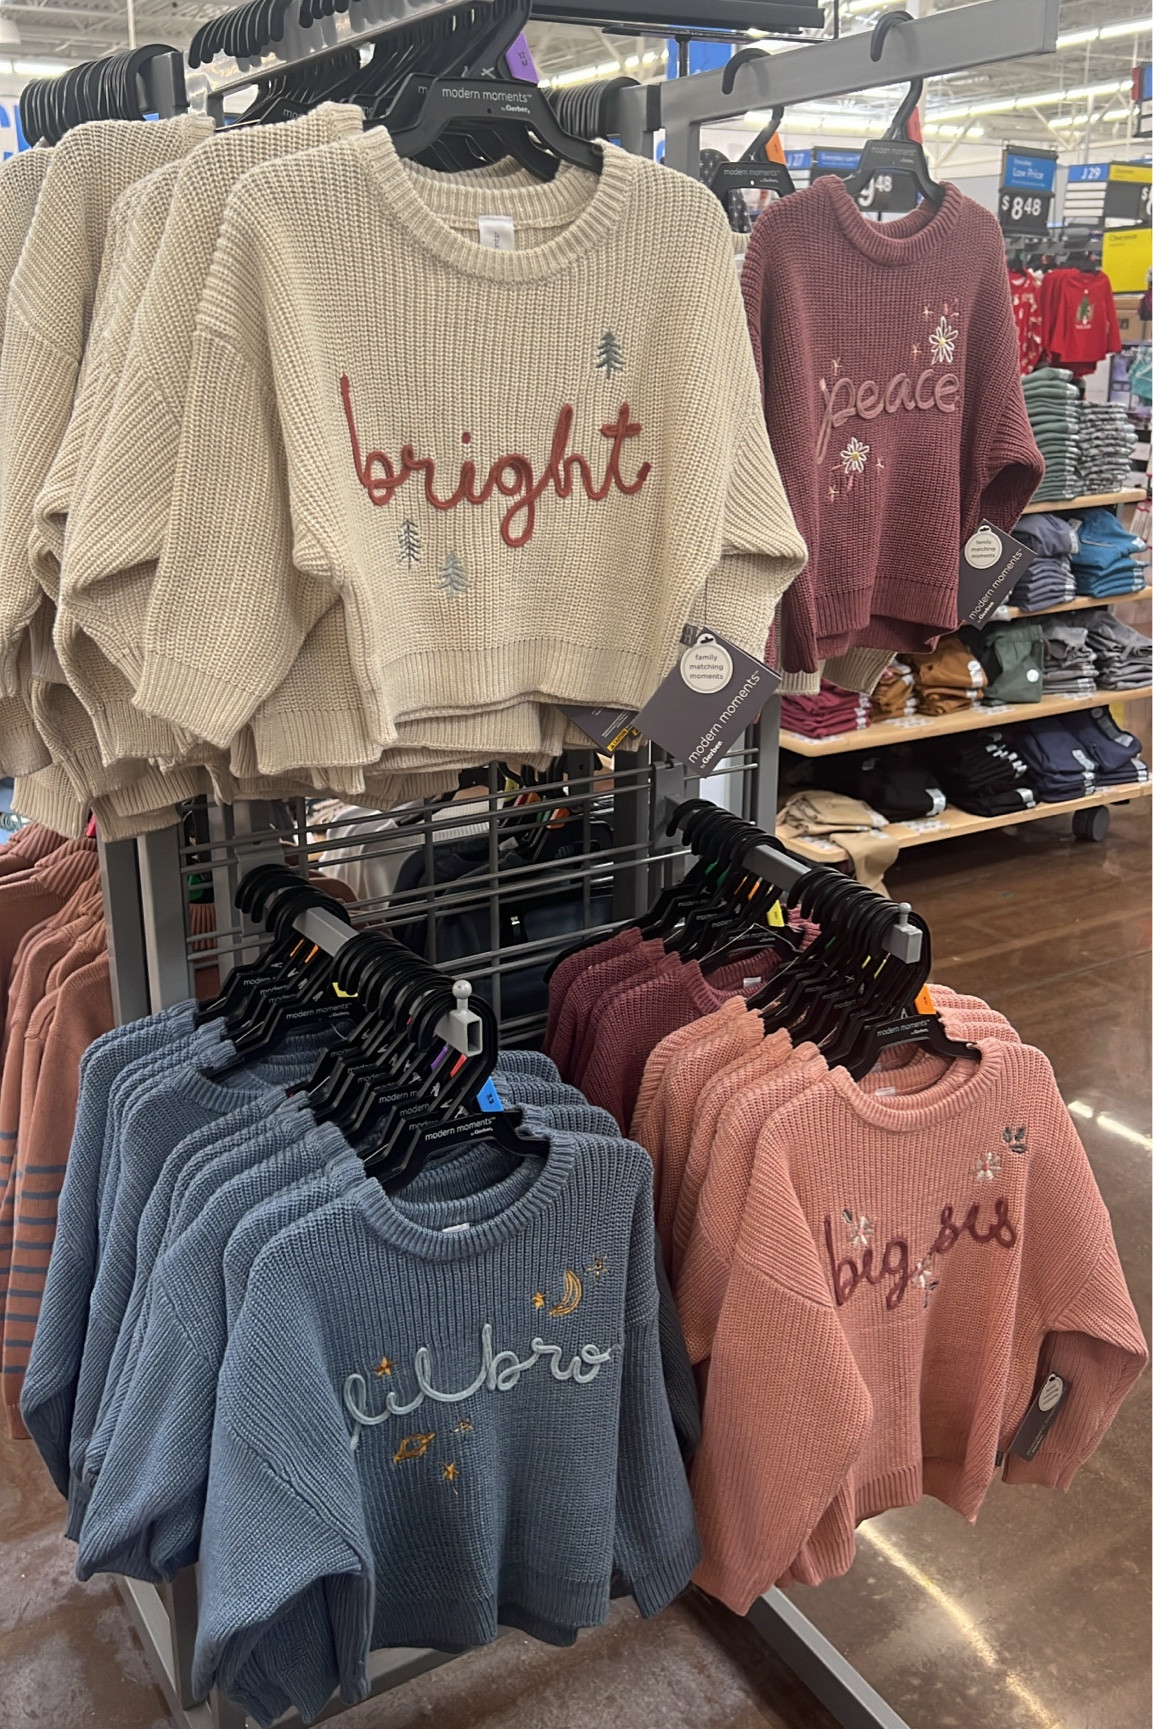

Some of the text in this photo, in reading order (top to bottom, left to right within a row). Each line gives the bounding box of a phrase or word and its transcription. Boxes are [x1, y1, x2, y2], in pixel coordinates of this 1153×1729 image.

[442, 87, 480, 99] modern
[482, 91, 528, 103] moments
[724, 168, 748, 176] modern
[816, 369, 960, 464] peace
[340, 373, 651, 548] bright
[969, 551, 1023, 620] modern moments
[695, 653, 718, 662] family
[689, 663, 724, 671] matching
[689, 672, 723, 680] moments
[688, 673, 761, 764] modern moments
[702, 741, 723, 765] Gerber
[286, 1007, 315, 1019] modern
[877, 1026, 900, 1037] modern
[379, 1092, 409, 1104] modern
[400, 1103, 430, 1117] modern
[425, 1118, 493, 1141] modern moments
[824, 1197, 1016, 1312] big sis
[344, 1323, 614, 1450] lil bro
